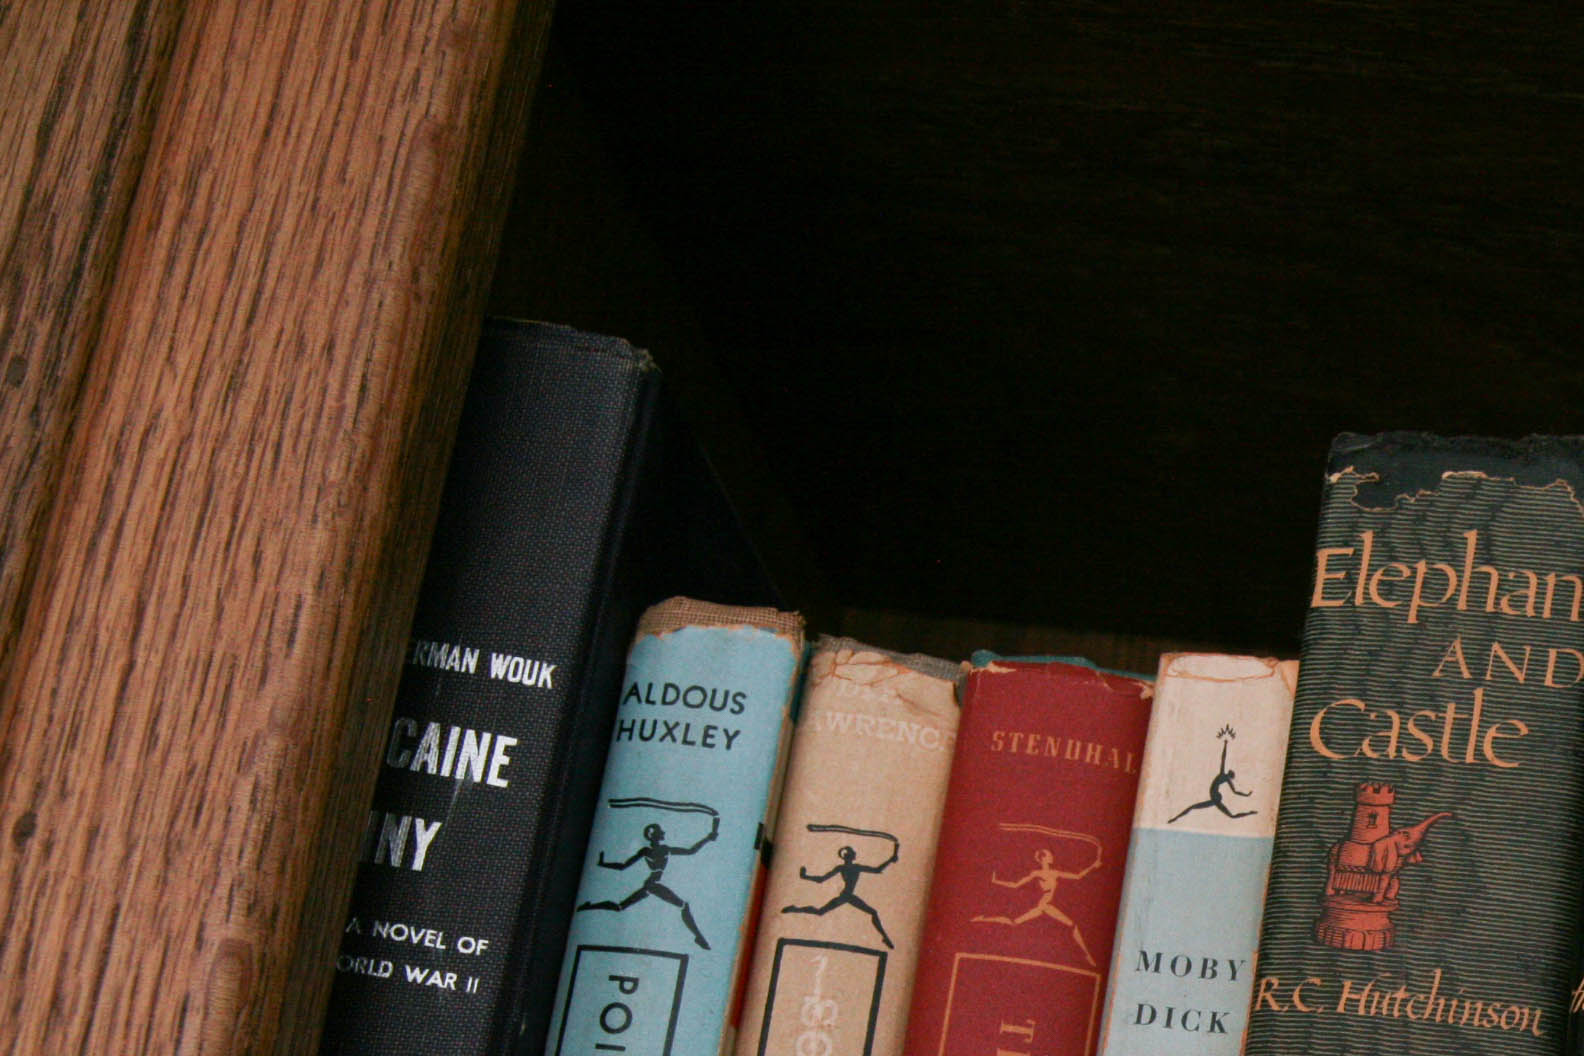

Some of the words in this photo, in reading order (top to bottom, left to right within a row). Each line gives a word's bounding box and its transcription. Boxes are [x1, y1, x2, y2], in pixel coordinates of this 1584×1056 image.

[412, 640, 480, 674] RMAN
[490, 652, 557, 689] WOUK
[623, 681, 748, 715] ALDOUS
[616, 719, 742, 751] HUXLEY
[1309, 687, 1530, 768] Castle
[386, 717, 518, 788] CAINE
[991, 730, 1138, 776] STENDHAL
[372, 920, 446, 950] NOVEL
[457, 936, 489, 956] OF
[336, 955, 393, 979] ORLD
[404, 964, 458, 990] WAR
[466, 976, 480, 994] II
[1136, 950, 1247, 982] MOBY
[1133, 1003, 1232, 1034] DICK
[1336, 968, 1546, 1037] Hutchinson
